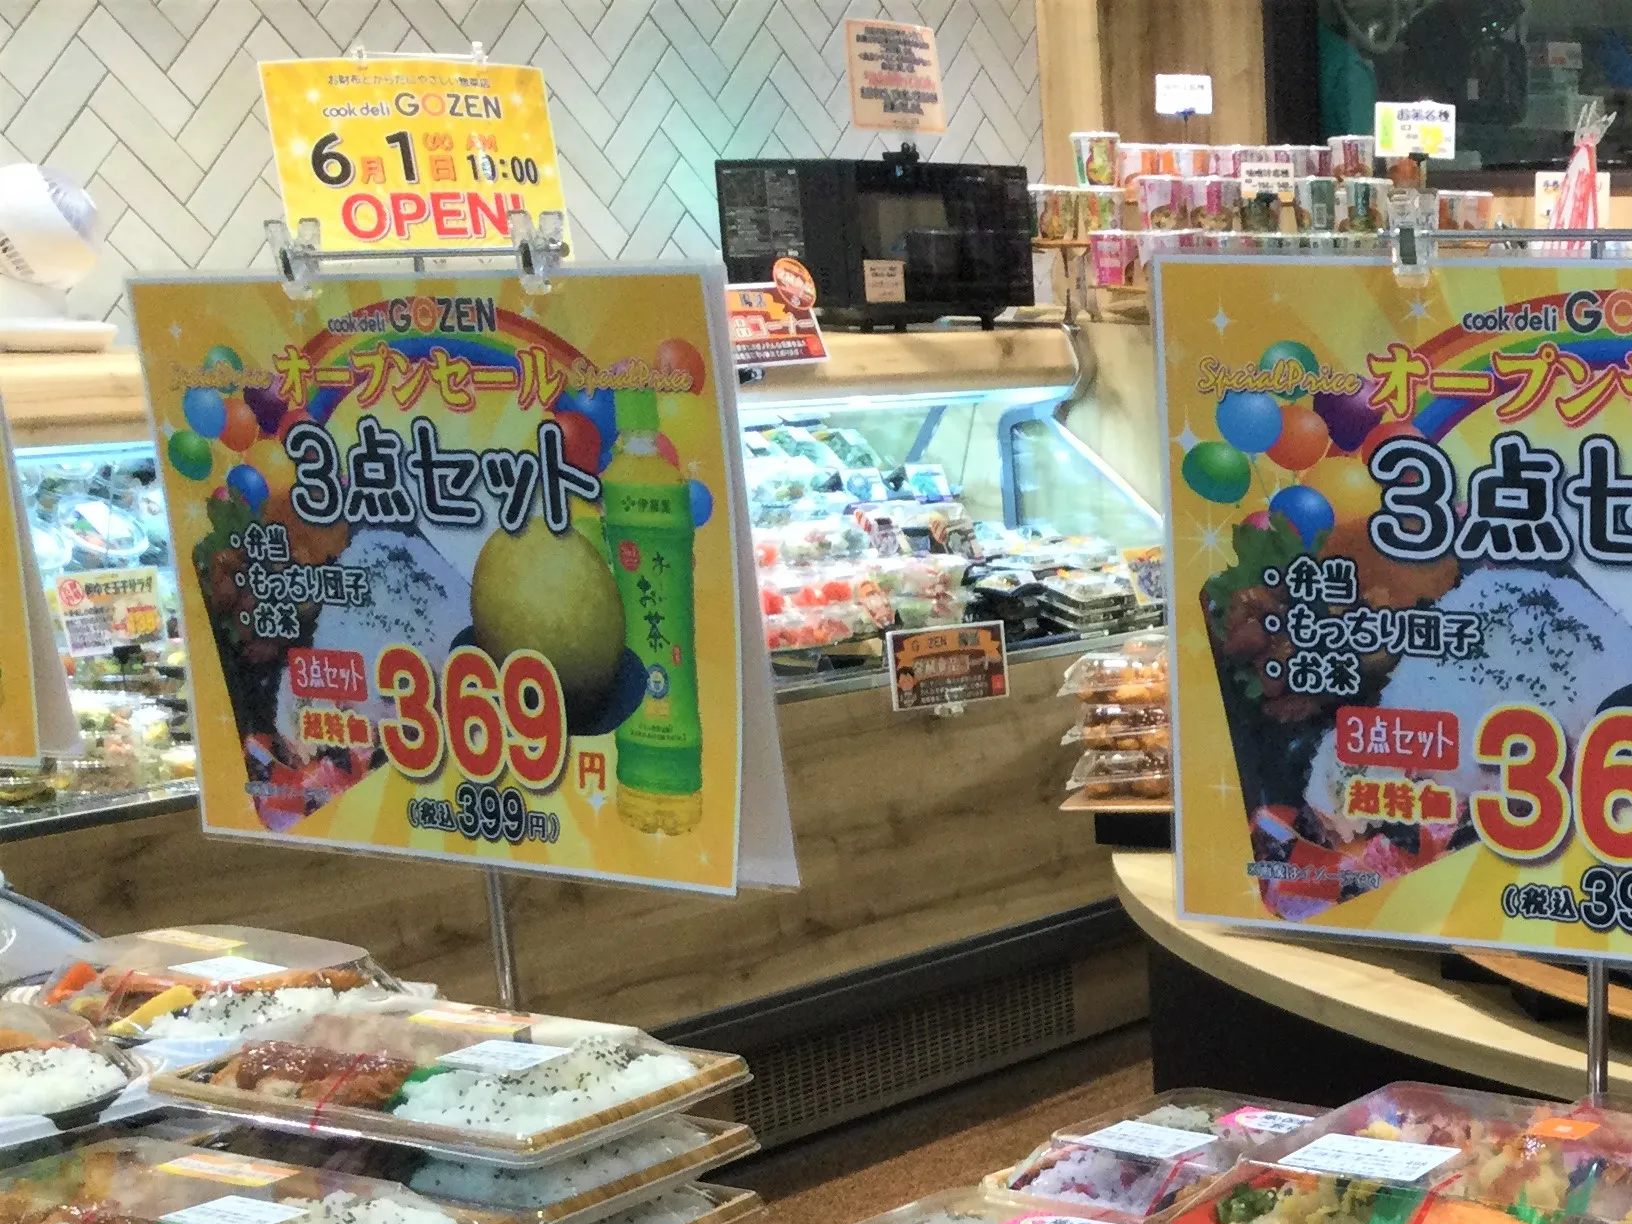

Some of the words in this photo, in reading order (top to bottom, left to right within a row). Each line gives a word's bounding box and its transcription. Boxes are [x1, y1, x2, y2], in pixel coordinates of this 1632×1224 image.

[322, 100, 357, 118] cook
[360, 98, 391, 117] deli
[394, 92, 502, 119] GOZEN
[327, 310, 358, 334] cook
[358, 310, 386, 334] deli
[388, 296, 497, 334] GOZEN
[1462, 304, 1513, 332] cook
[1514, 305, 1558, 333] deli
[271, 340, 565, 414] オープンセール
[284, 413, 601, 534] 3点セット
[243, 523, 291, 563] 弁当
[248, 565, 372, 608] もっちり団子
[1285, 556, 1359, 604] 弁当
[253, 605, 301, 640] お茶
[1286, 604, 1485, 657] もっちり団子
[293, 655, 365, 694] 3点セット
[1286, 651, 1362, 695] お茶
[300, 709, 372, 748] 超特価
[376, 645, 569, 790] 369
[577, 750, 608, 792] 円
[1345, 715, 1454, 760] 3点セット
[1343, 778, 1458, 823] 超特価
